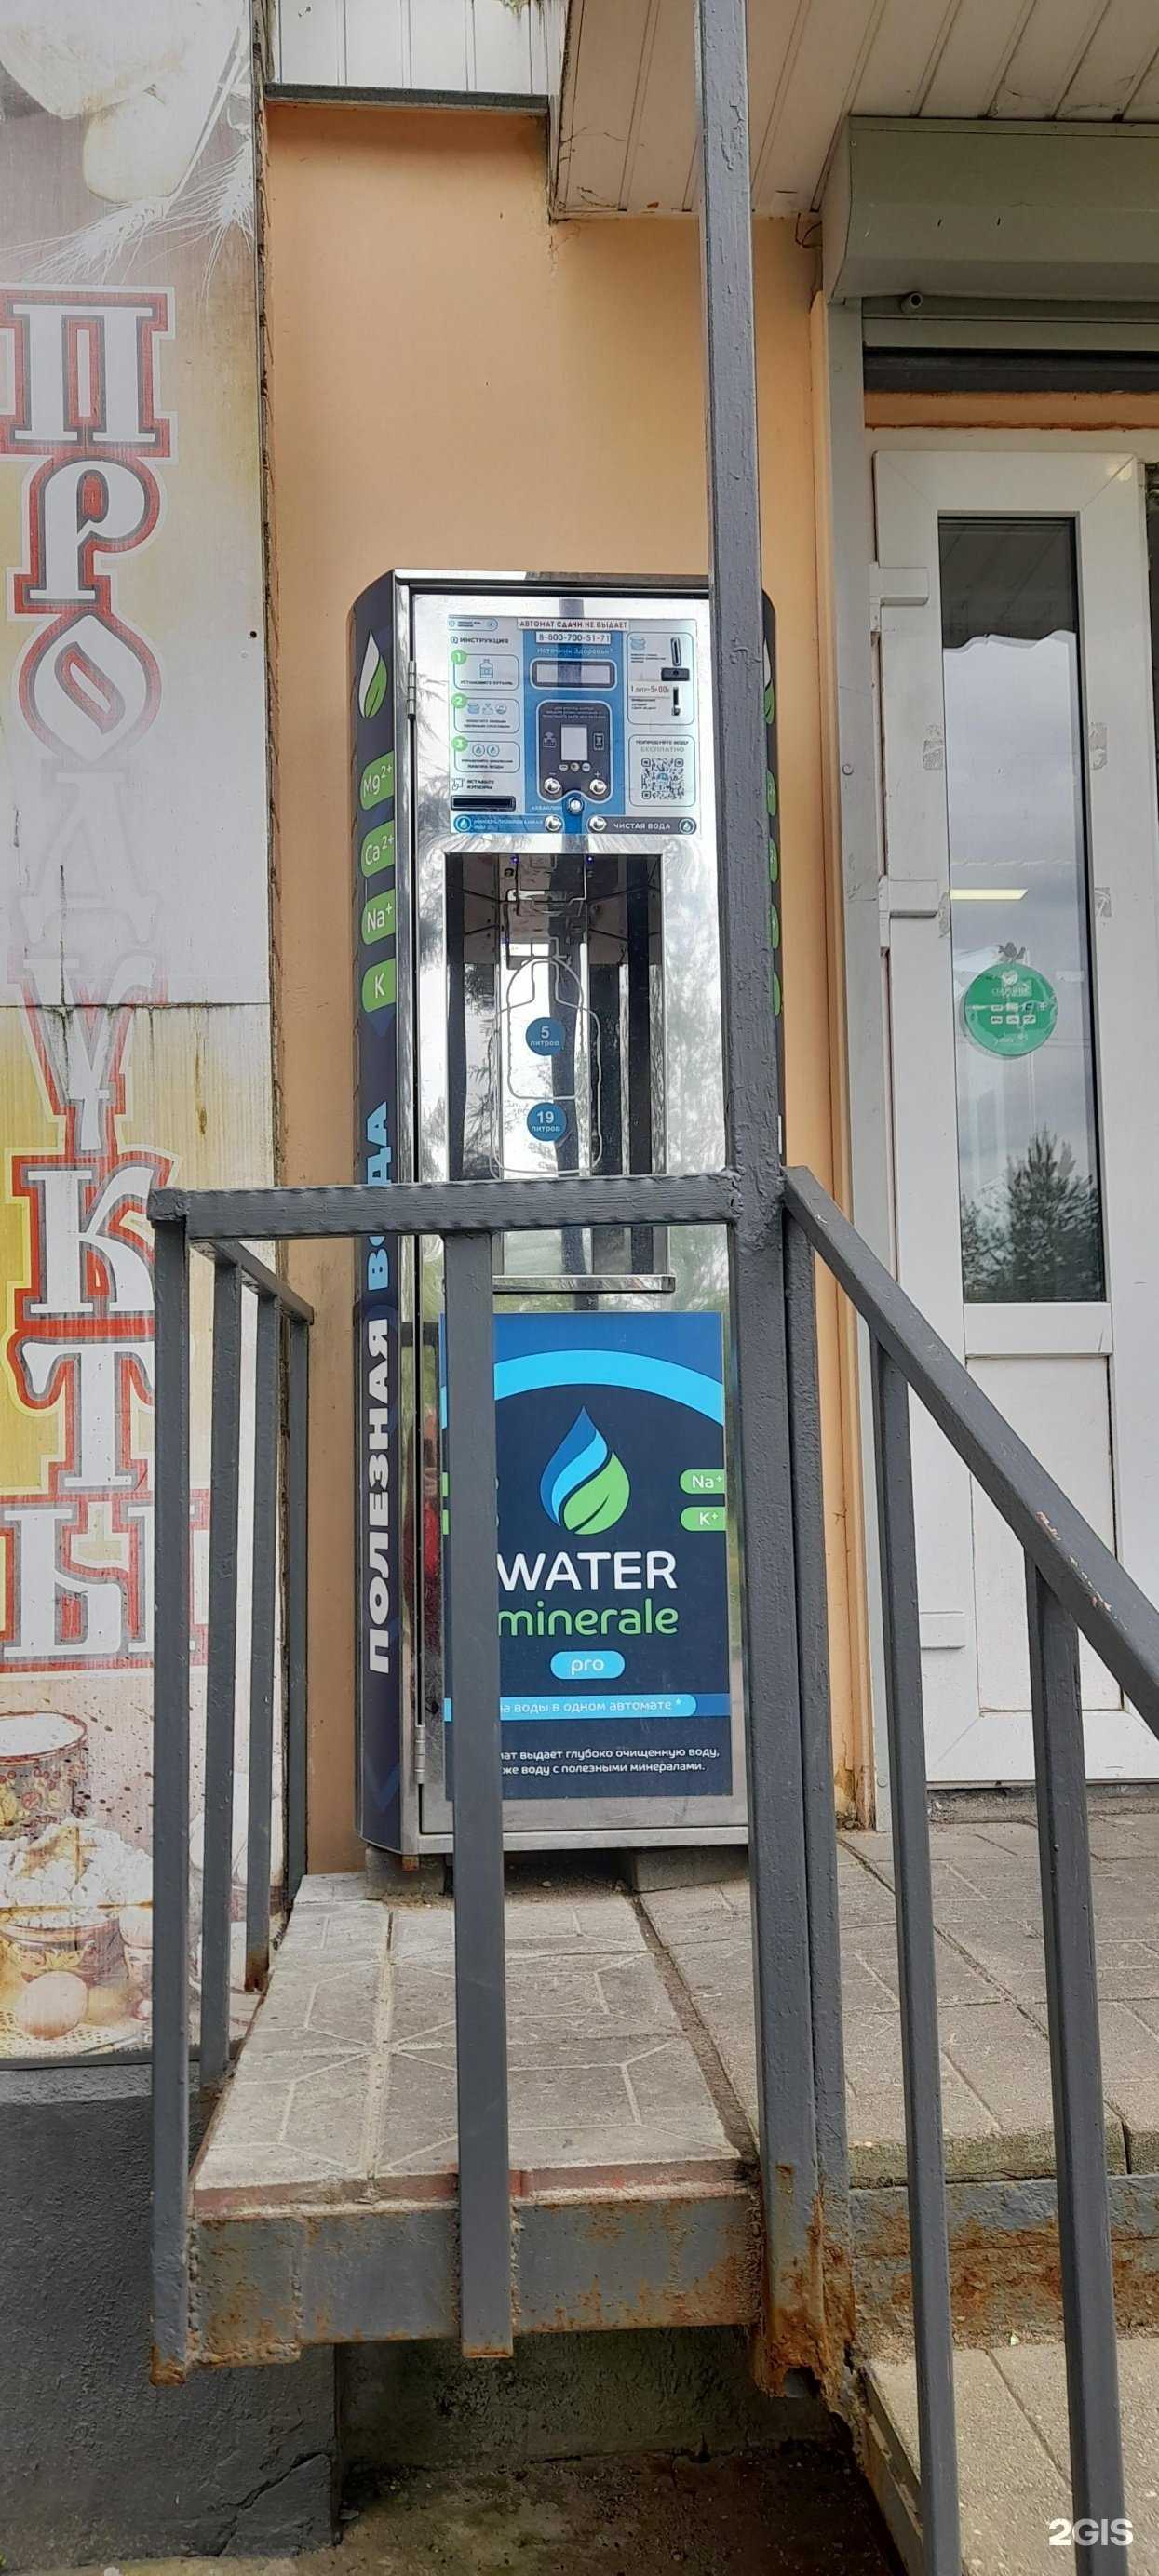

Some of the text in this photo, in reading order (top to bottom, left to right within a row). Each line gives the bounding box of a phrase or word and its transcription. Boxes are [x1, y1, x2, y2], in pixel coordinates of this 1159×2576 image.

[539, 633, 610, 642] 8-800-700-51-71
[374, 973, 385, 998] K
[541, 1026, 549, 1039] 5
[536, 1111, 555, 1123] 19
[367, 1102, 392, 1674] ПОЛЕЗНАЯ ВДА
[496, 1550, 678, 1591] WATER
[497, 1598, 679, 1637] minerale
[571, 1657, 604, 1676] pro
[514, 1703, 549, 1714] воды
[553, 1703, 559, 1711] в
[563, 1701, 606, 1712] одном
[609, 1700, 671, 1711] автомате
[520, 1750, 563, 1762] выдает
[566, 1748, 613, 1761] глубоко
[615, 1748, 686, 1761] очищенную
[689, 1747, 720, 1758] воду,
[521, 1765, 550, 1777] воду
[553, 1765, 559, 1774] с
[561, 1764, 627, 1774] полезными
[629, 1761, 705, 1774] минералами.
